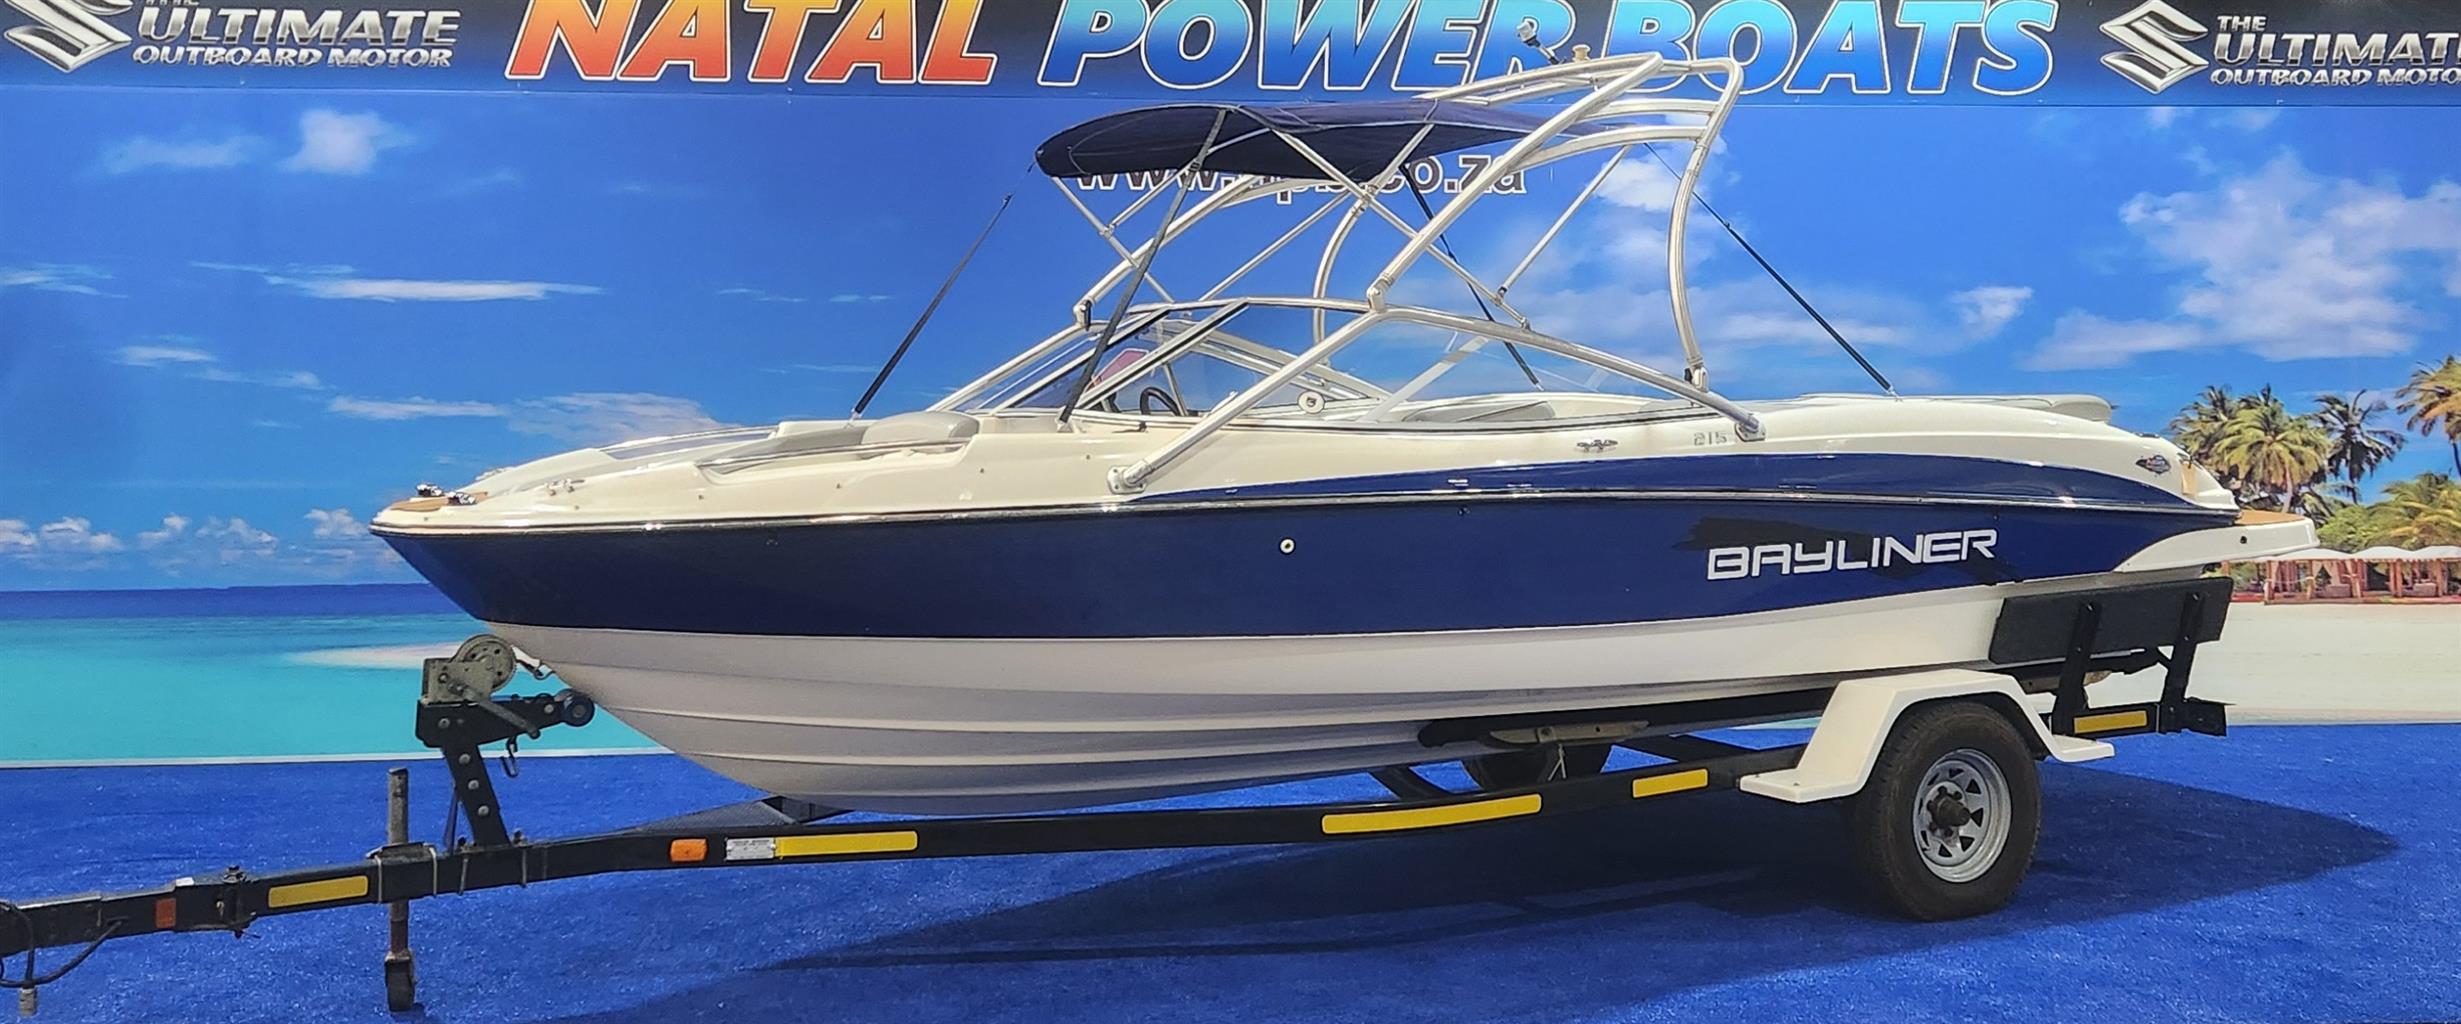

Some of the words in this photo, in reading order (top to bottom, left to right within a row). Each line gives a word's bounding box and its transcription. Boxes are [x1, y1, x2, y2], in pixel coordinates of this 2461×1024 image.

[137, 6, 462, 47] ULTIMATE
[2215, 15, 2267, 32] THE
[132, 45, 322, 66] OUTBOARD
[327, 47, 454, 69] MOTOR
[505, 0, 998, 84] NATAL
[1037, 0, 1576, 92] POWER
[1596, 0, 2060, 96] BOATS
[2212, 32, 2461, 67] ULTIMAT
[2209, 67, 2372, 86] OUTBOARD
[1693, 431, 1728, 446] 215
[1706, 528, 1998, 581] BAYLINER
